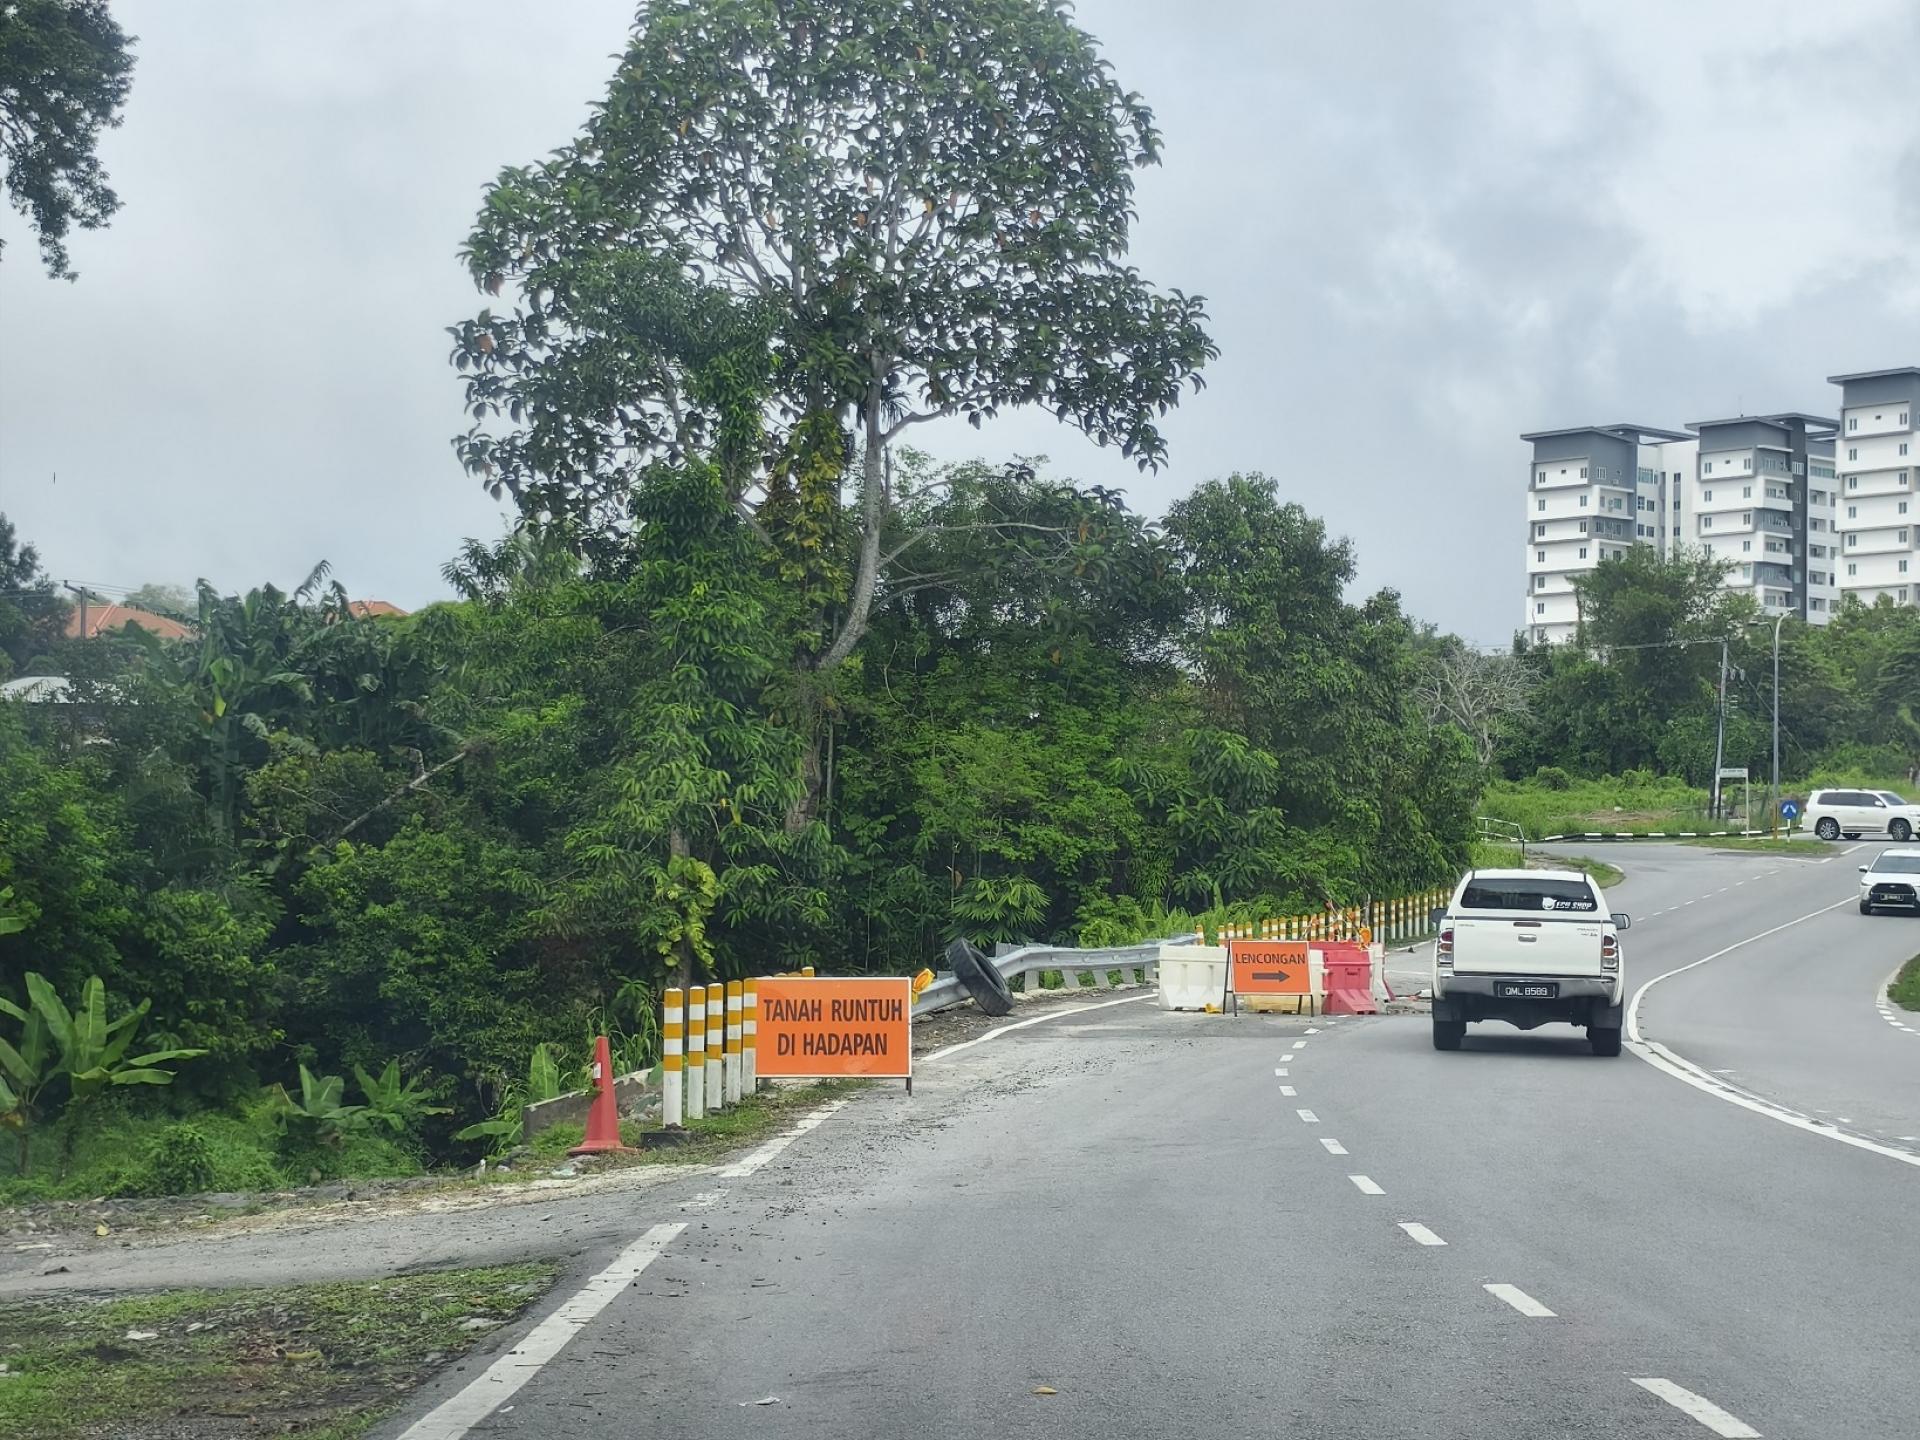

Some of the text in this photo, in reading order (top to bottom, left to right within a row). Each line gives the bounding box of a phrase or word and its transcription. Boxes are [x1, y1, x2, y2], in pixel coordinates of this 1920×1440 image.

[1571, 901, 1592, 910] SHOP
[1235, 953, 1306, 965] LENCONGAN
[763, 999, 903, 1022] TANAH RUNTUH
[777, 1033, 888, 1056] DI HADAPAN
